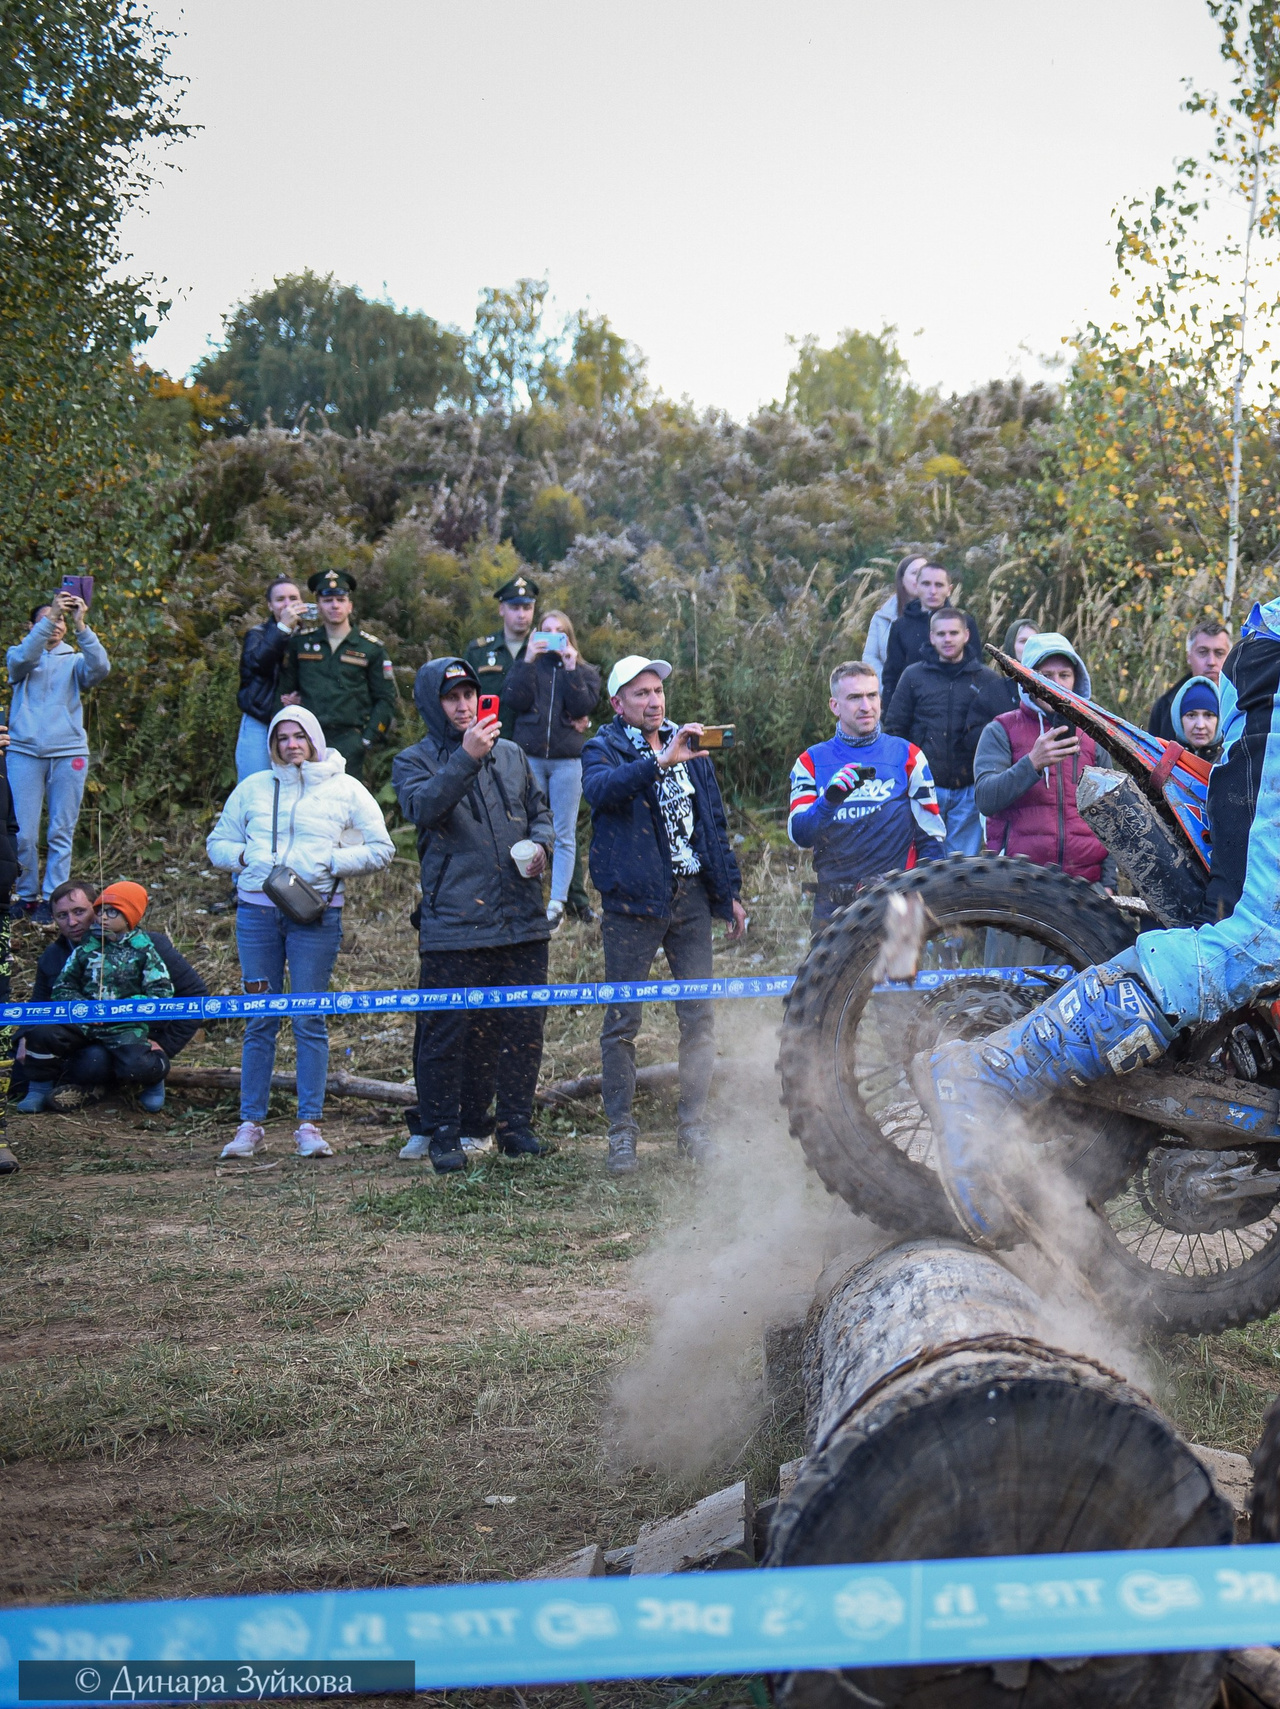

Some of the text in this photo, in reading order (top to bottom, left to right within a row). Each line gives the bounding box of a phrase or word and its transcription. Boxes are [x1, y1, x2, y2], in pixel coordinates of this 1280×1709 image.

[111, 1003, 134, 1015] DRC
[243, 999, 266, 1011] DRC
[375, 994, 397, 1006] DRC
[506, 990, 528, 1002] DRC
[636, 985, 658, 997] DRC
[766, 980, 788, 991] DRC
